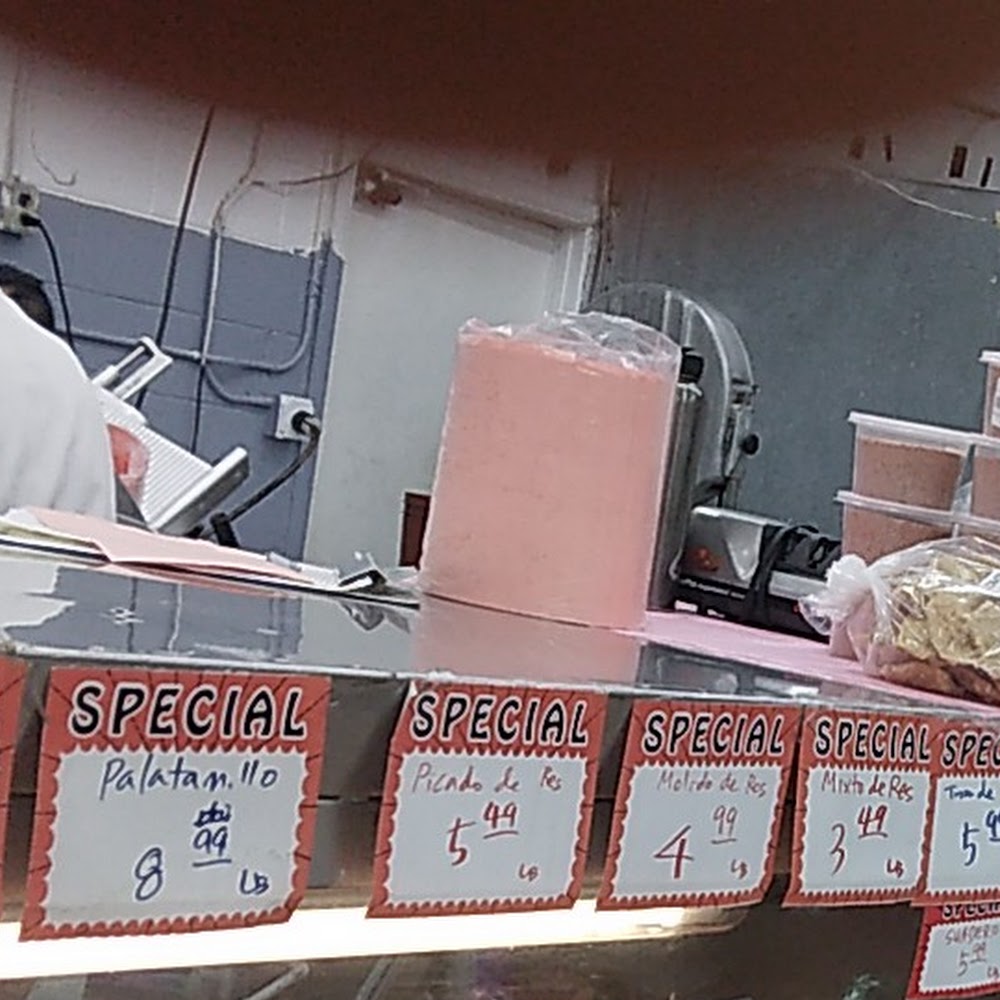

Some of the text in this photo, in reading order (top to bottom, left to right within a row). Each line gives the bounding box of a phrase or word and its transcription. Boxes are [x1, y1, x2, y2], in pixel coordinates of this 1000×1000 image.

[70, 684, 307, 738] SPECIAL
[411, 693, 587, 744] SPECIAL
[642, 713, 784, 754] SPECIAL
[815, 719, 931, 761] SPECIAL
[494, 766, 520, 793] de
[719, 773, 740, 793] de
[868, 774, 885, 797] de
[446, 817, 477, 867] 5
[483, 801, 519, 830] 49
[653, 824, 695, 880] 4
[712, 804, 739, 838] 99
[830, 822, 847, 876] 3
[857, 804, 888, 836] 49
[961, 821, 981, 867] 5
[134, 847, 164, 902] 8
[193, 826, 229, 857] 99
